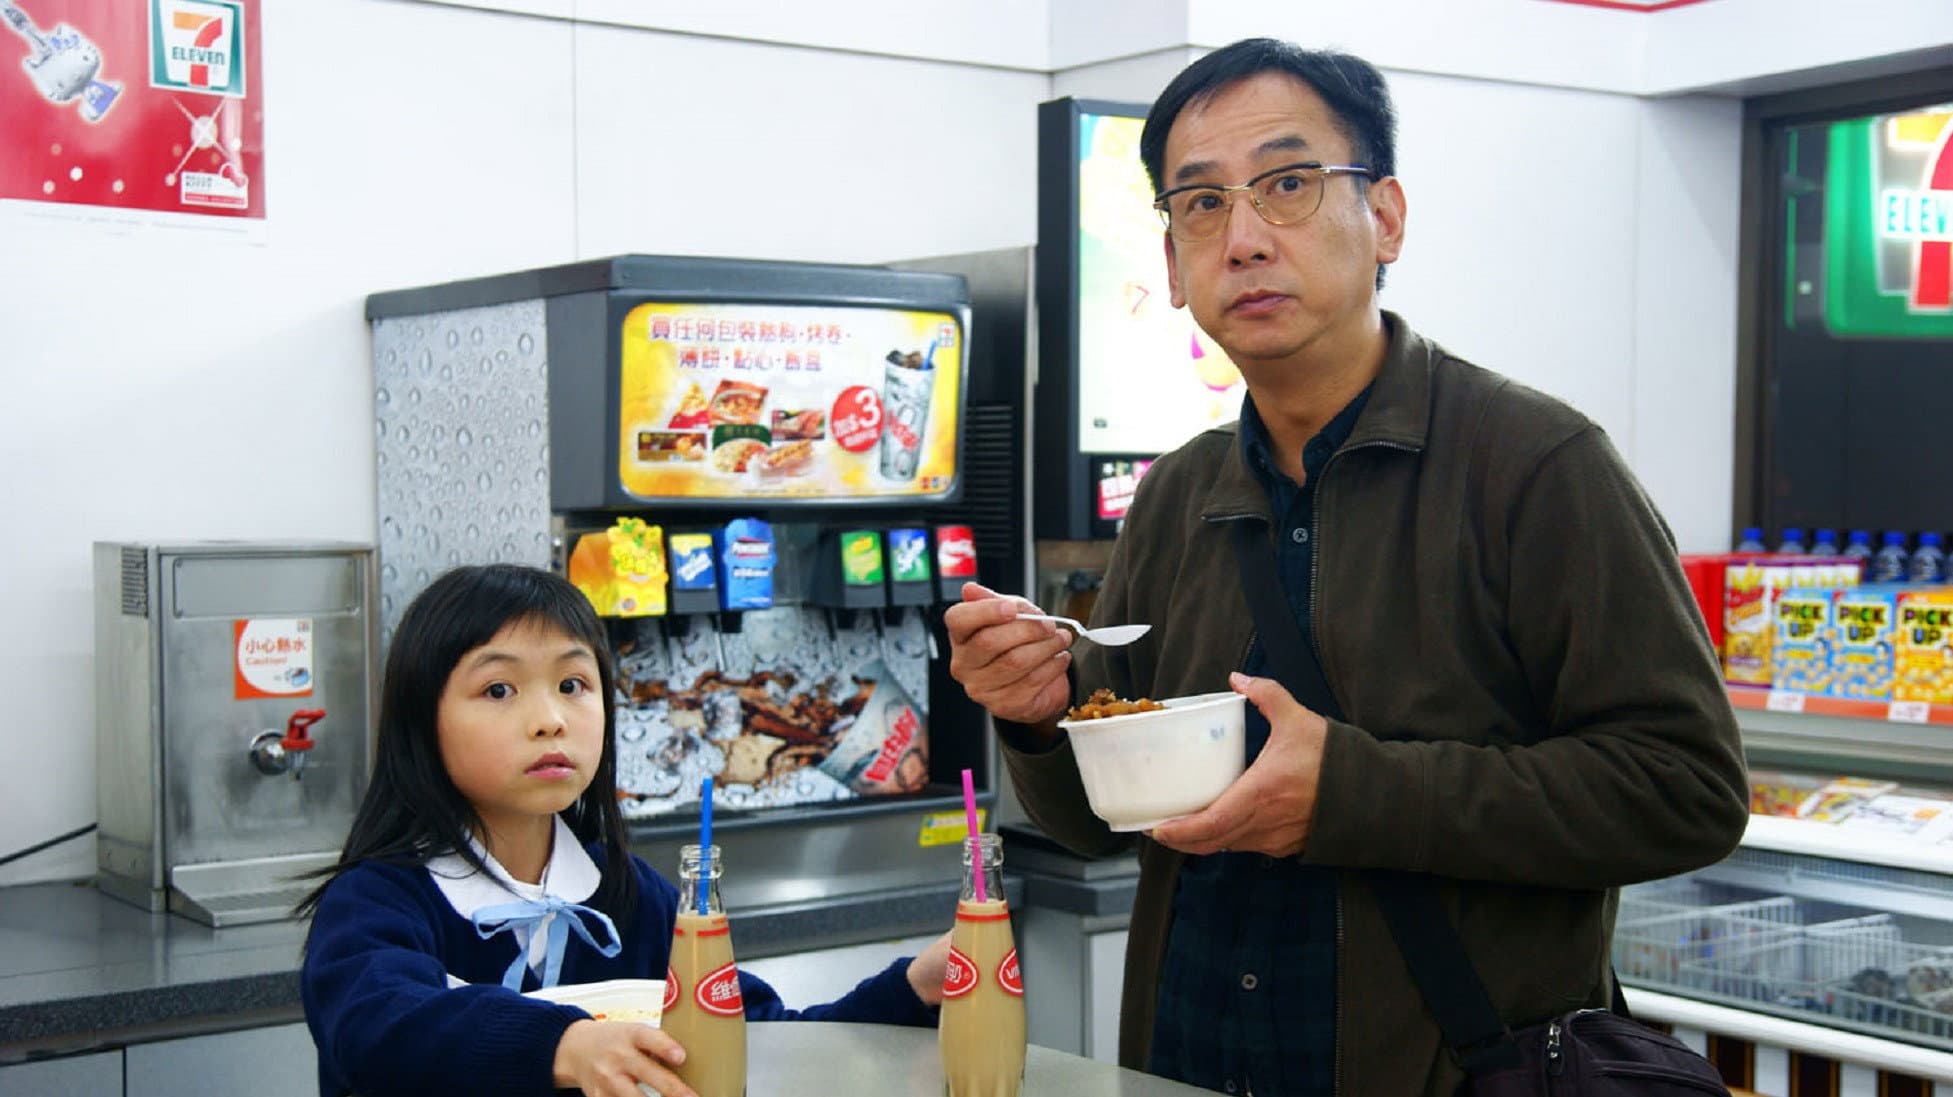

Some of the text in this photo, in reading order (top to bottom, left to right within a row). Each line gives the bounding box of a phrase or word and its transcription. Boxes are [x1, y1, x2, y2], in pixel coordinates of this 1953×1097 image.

[1780, 602, 1825, 620] PICK
[1839, 606, 1885, 625] PICK
[1903, 608, 1953, 627] PICK
[1788, 622, 1815, 638] UP
[1848, 624, 1876, 642] UP
[1912, 627, 1942, 645] UP
[246, 637, 306, 654] 小心熱水
